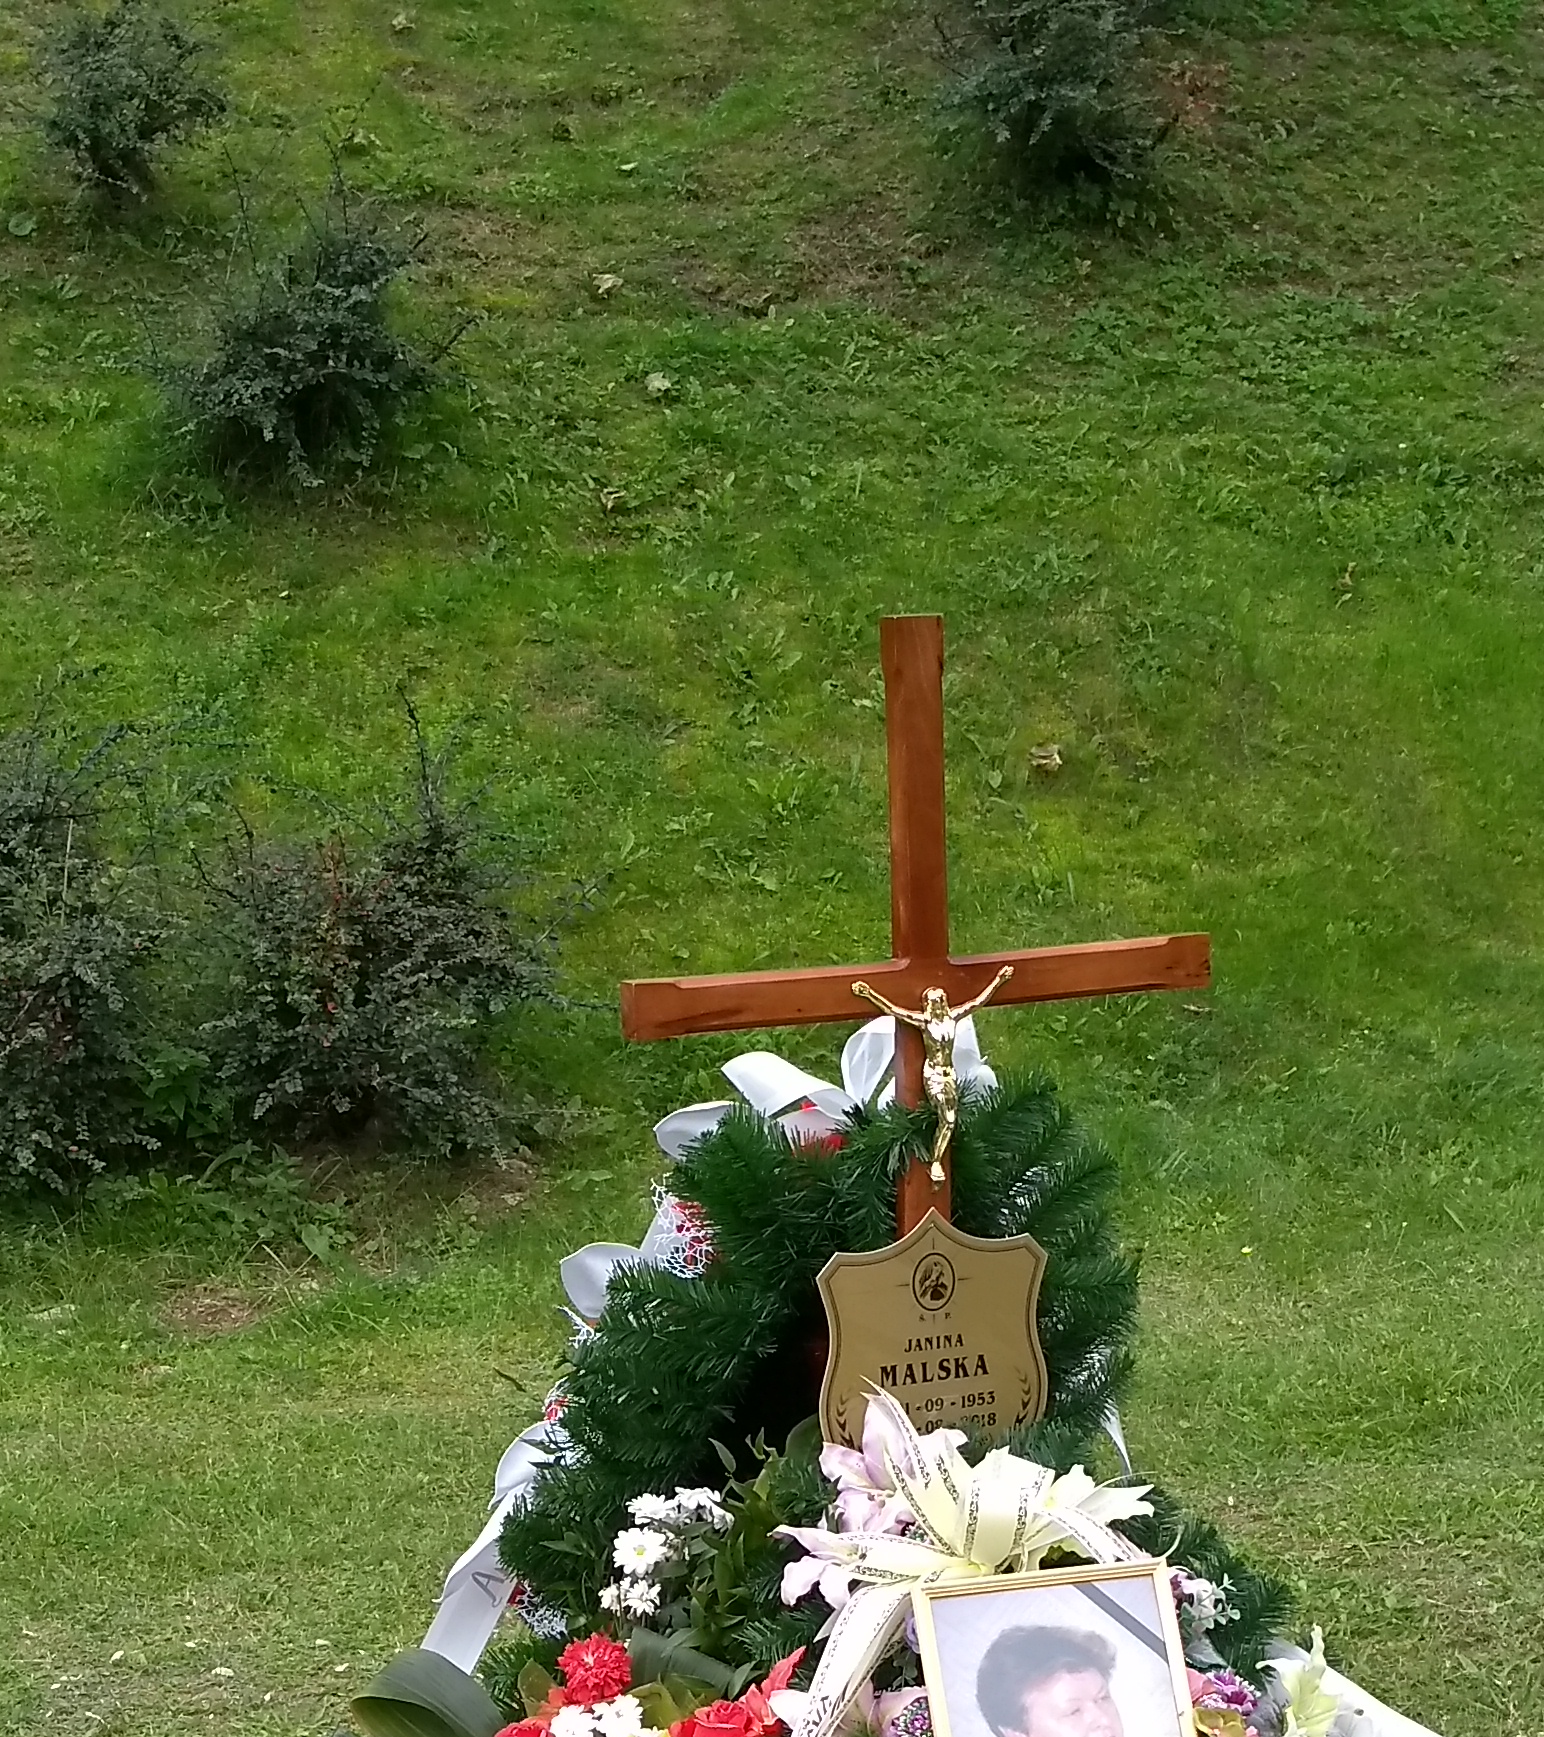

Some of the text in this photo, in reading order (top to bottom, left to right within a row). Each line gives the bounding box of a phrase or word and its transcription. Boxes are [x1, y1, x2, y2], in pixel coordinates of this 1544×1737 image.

[904, 1333, 964, 1353] JANINA
[880, 1354, 989, 1388] MALSKA
[925, 1397, 944, 1413] 09
[960, 1390, 996, 1409] 1953
